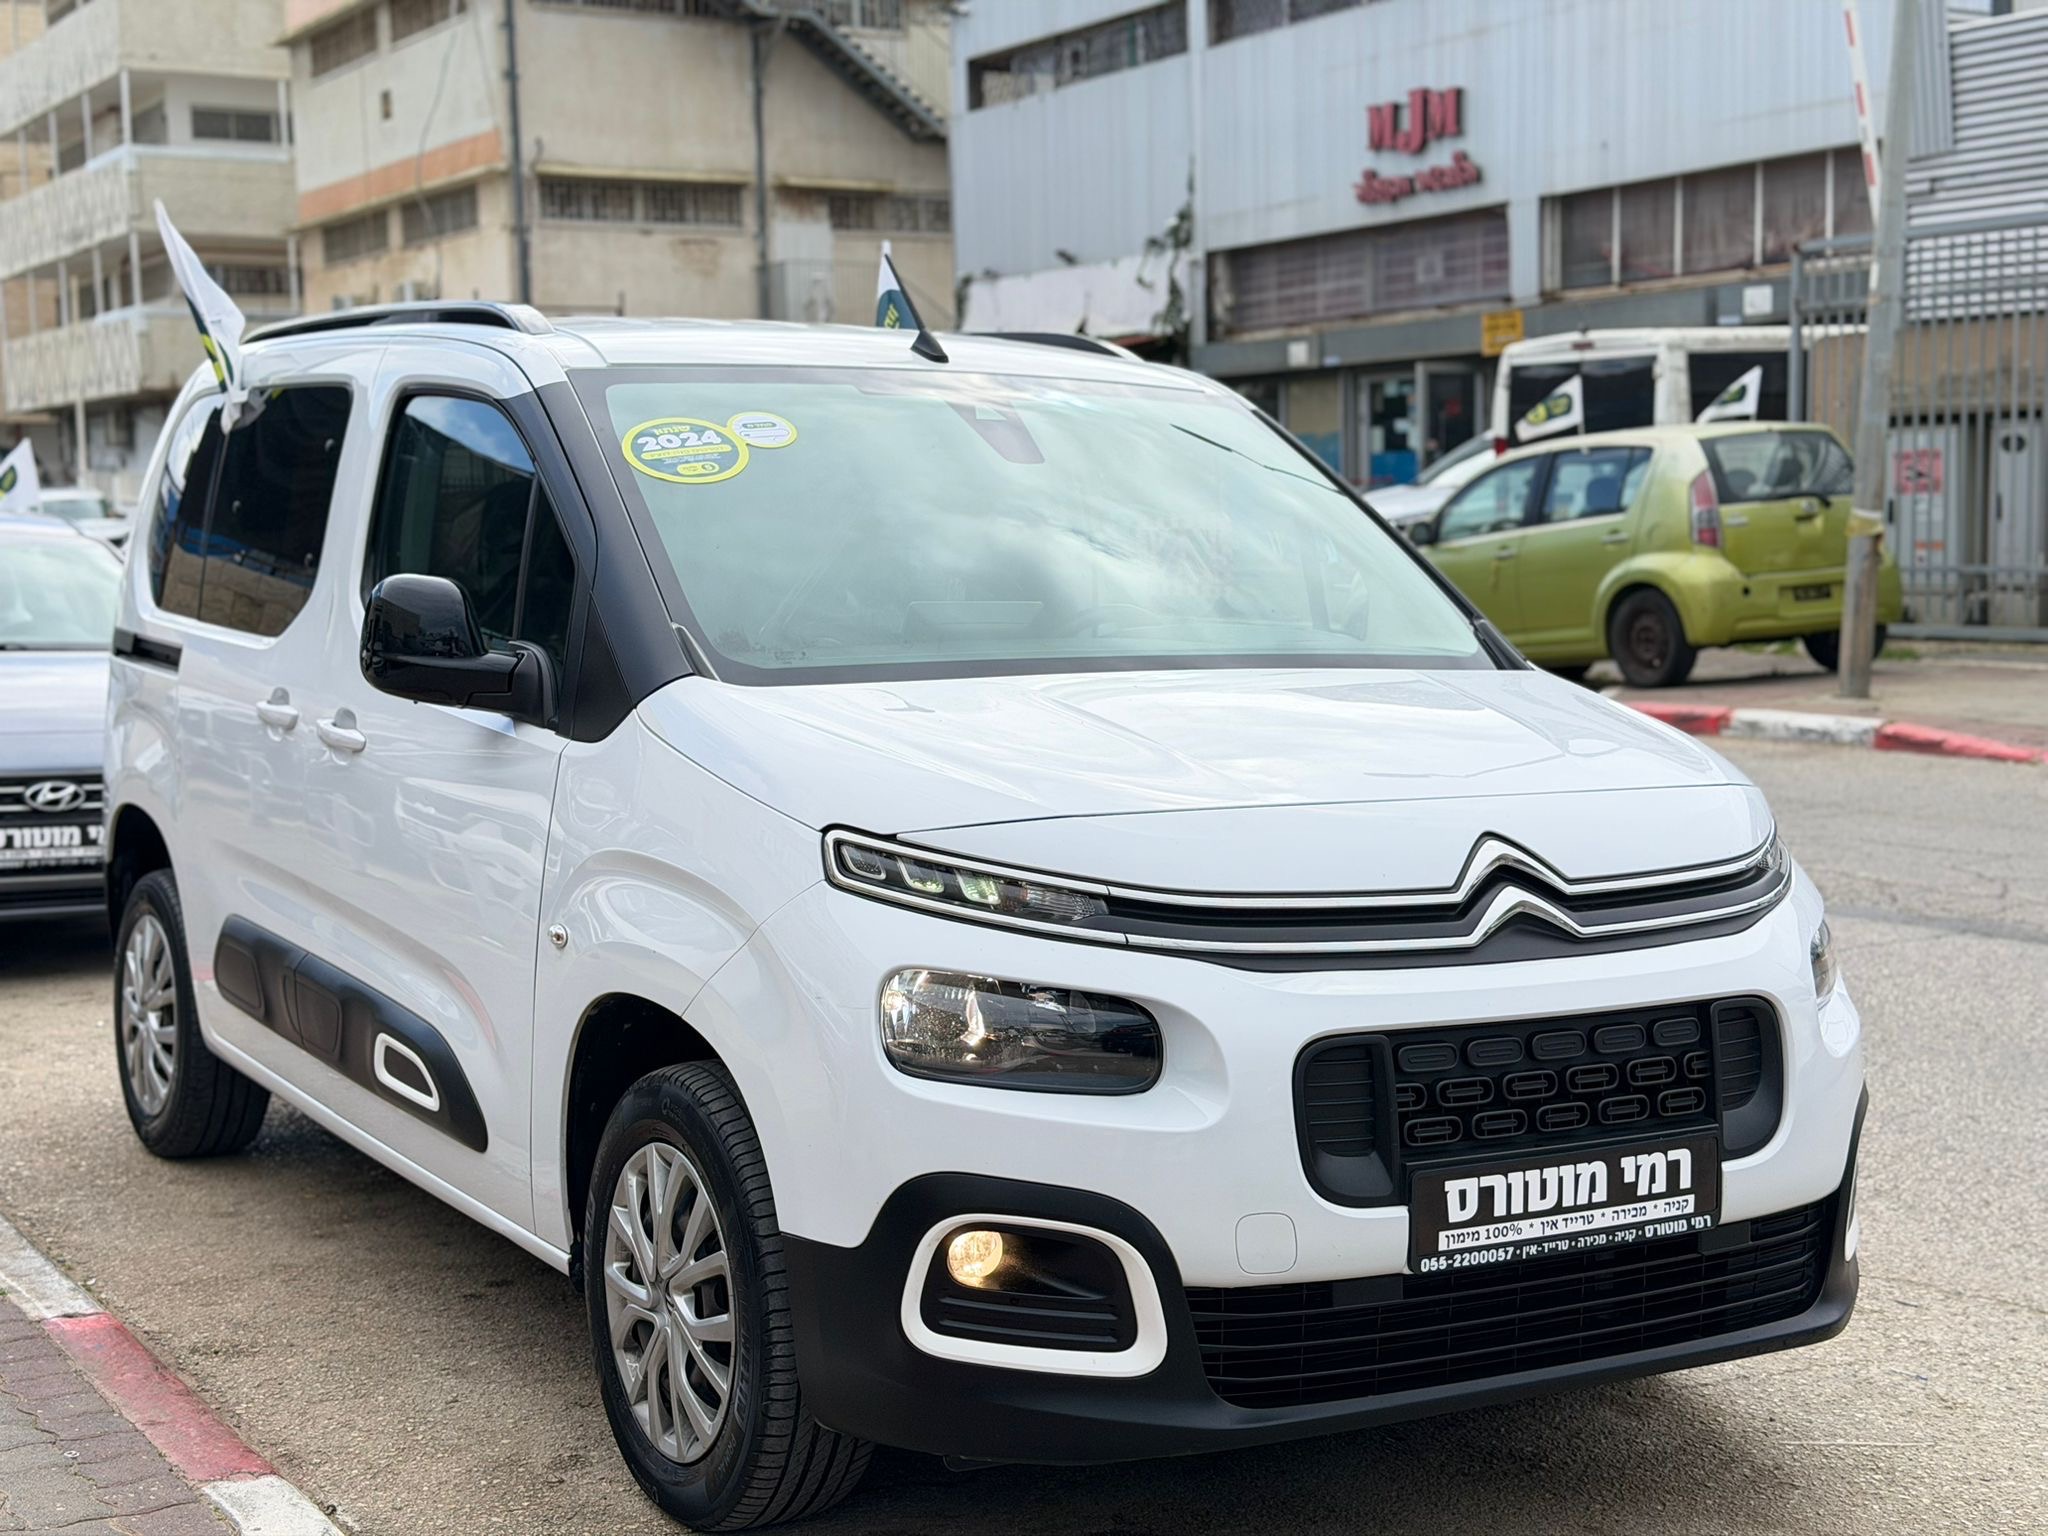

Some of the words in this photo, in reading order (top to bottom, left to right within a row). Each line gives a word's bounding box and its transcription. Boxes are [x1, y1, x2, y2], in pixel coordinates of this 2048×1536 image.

[637, 430, 722, 452] 2024
[1620, 1148, 1692, 1196] רמי
[1444, 1160, 1608, 1224] מוטורס
[1612, 1205, 1648, 1222] מכירה
[1663, 1198, 1689, 1214] קניה
[1540, 1219, 1559, 1236] אין
[1562, 1213, 1595, 1229] טרייד
[1645, 1219, 1688, 1239] מוטורס
[1691, 1215, 1712, 1229] רמי
[1445, 1230, 1481, 1249] מימון
[1484, 1223, 1523, 1240] 100%
[1614, 1229, 1637, 1243] קניה
[1577, 1234, 1607, 1248] מכירה
[1420, 1246, 1515, 1272] 055-2200057
